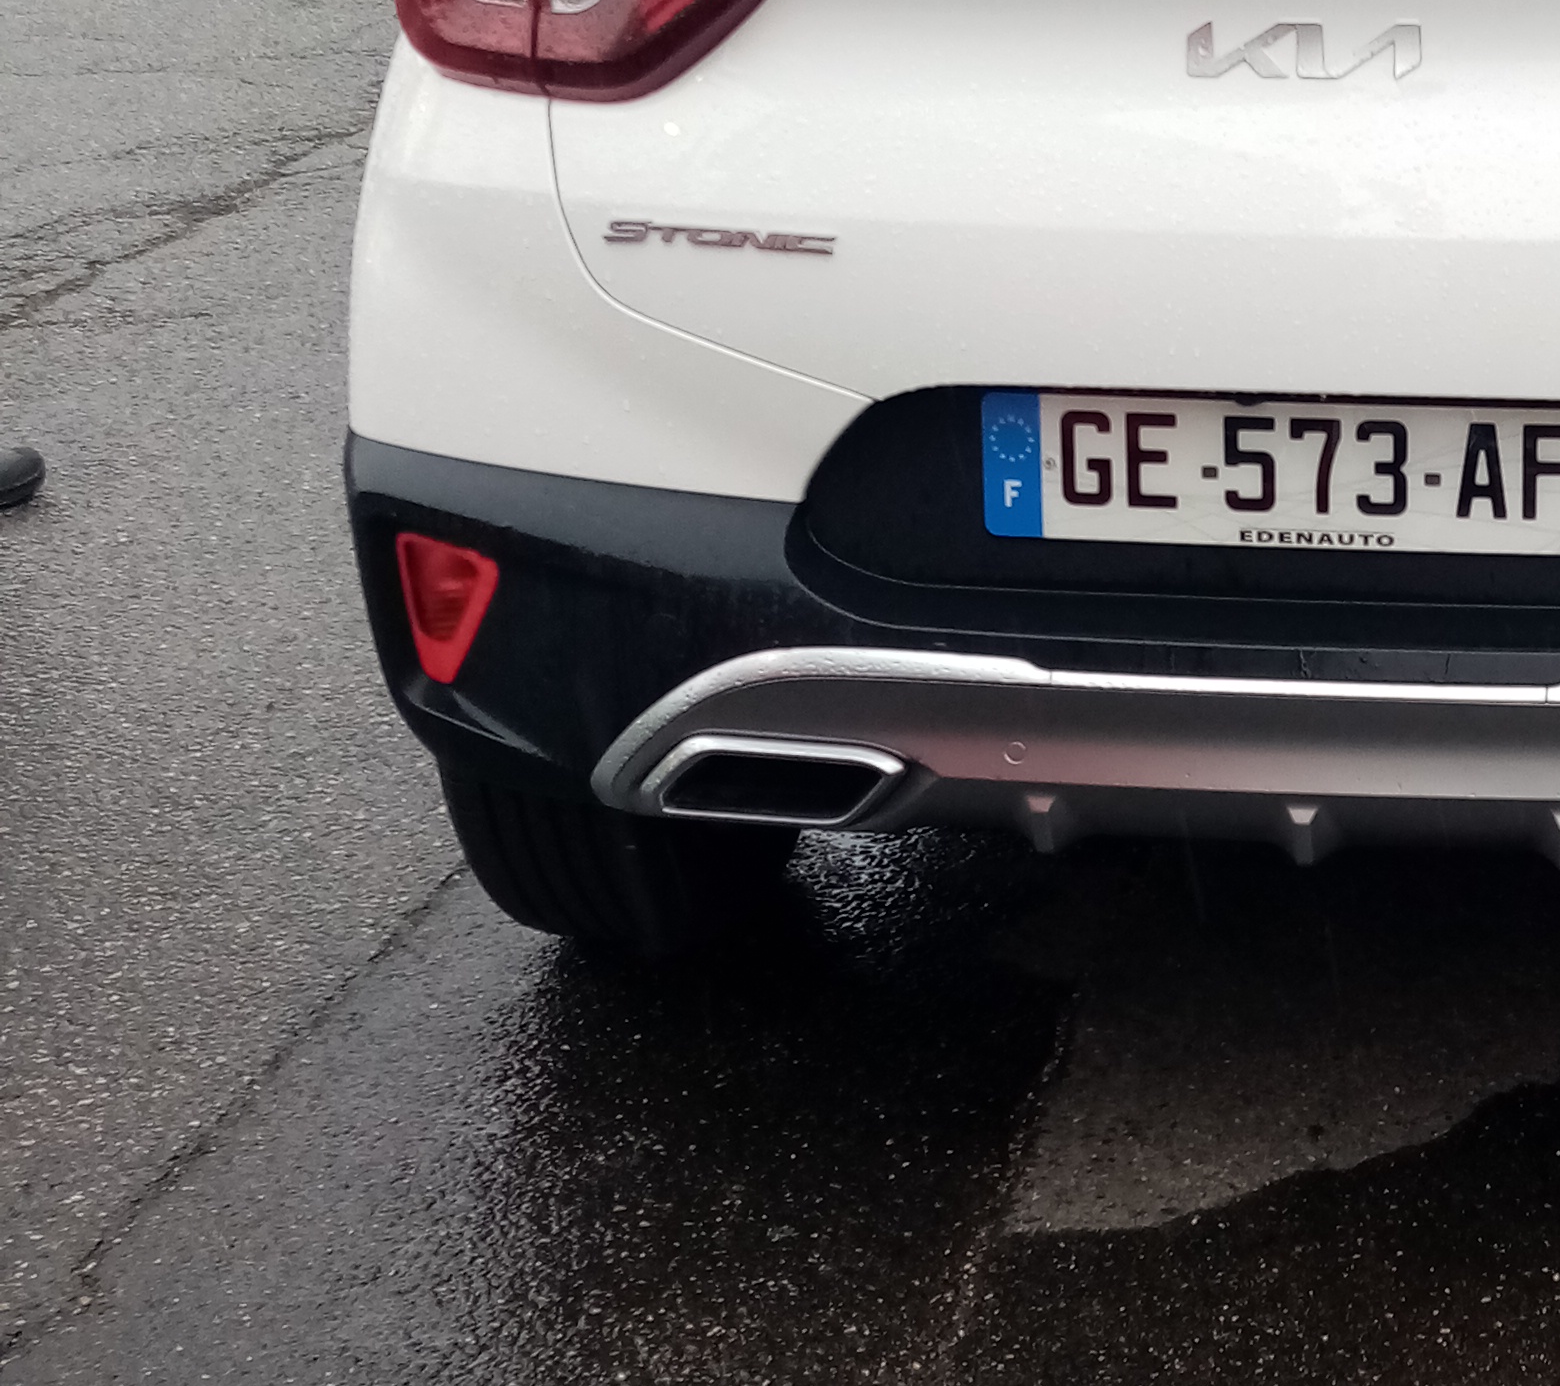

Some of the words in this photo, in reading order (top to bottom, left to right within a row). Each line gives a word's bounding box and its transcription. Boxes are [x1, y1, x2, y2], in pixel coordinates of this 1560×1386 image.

[603, 220, 838, 255] STONIC
[1002, 478, 1021, 508] F
[1238, 528, 1396, 548] EDENAUTO
